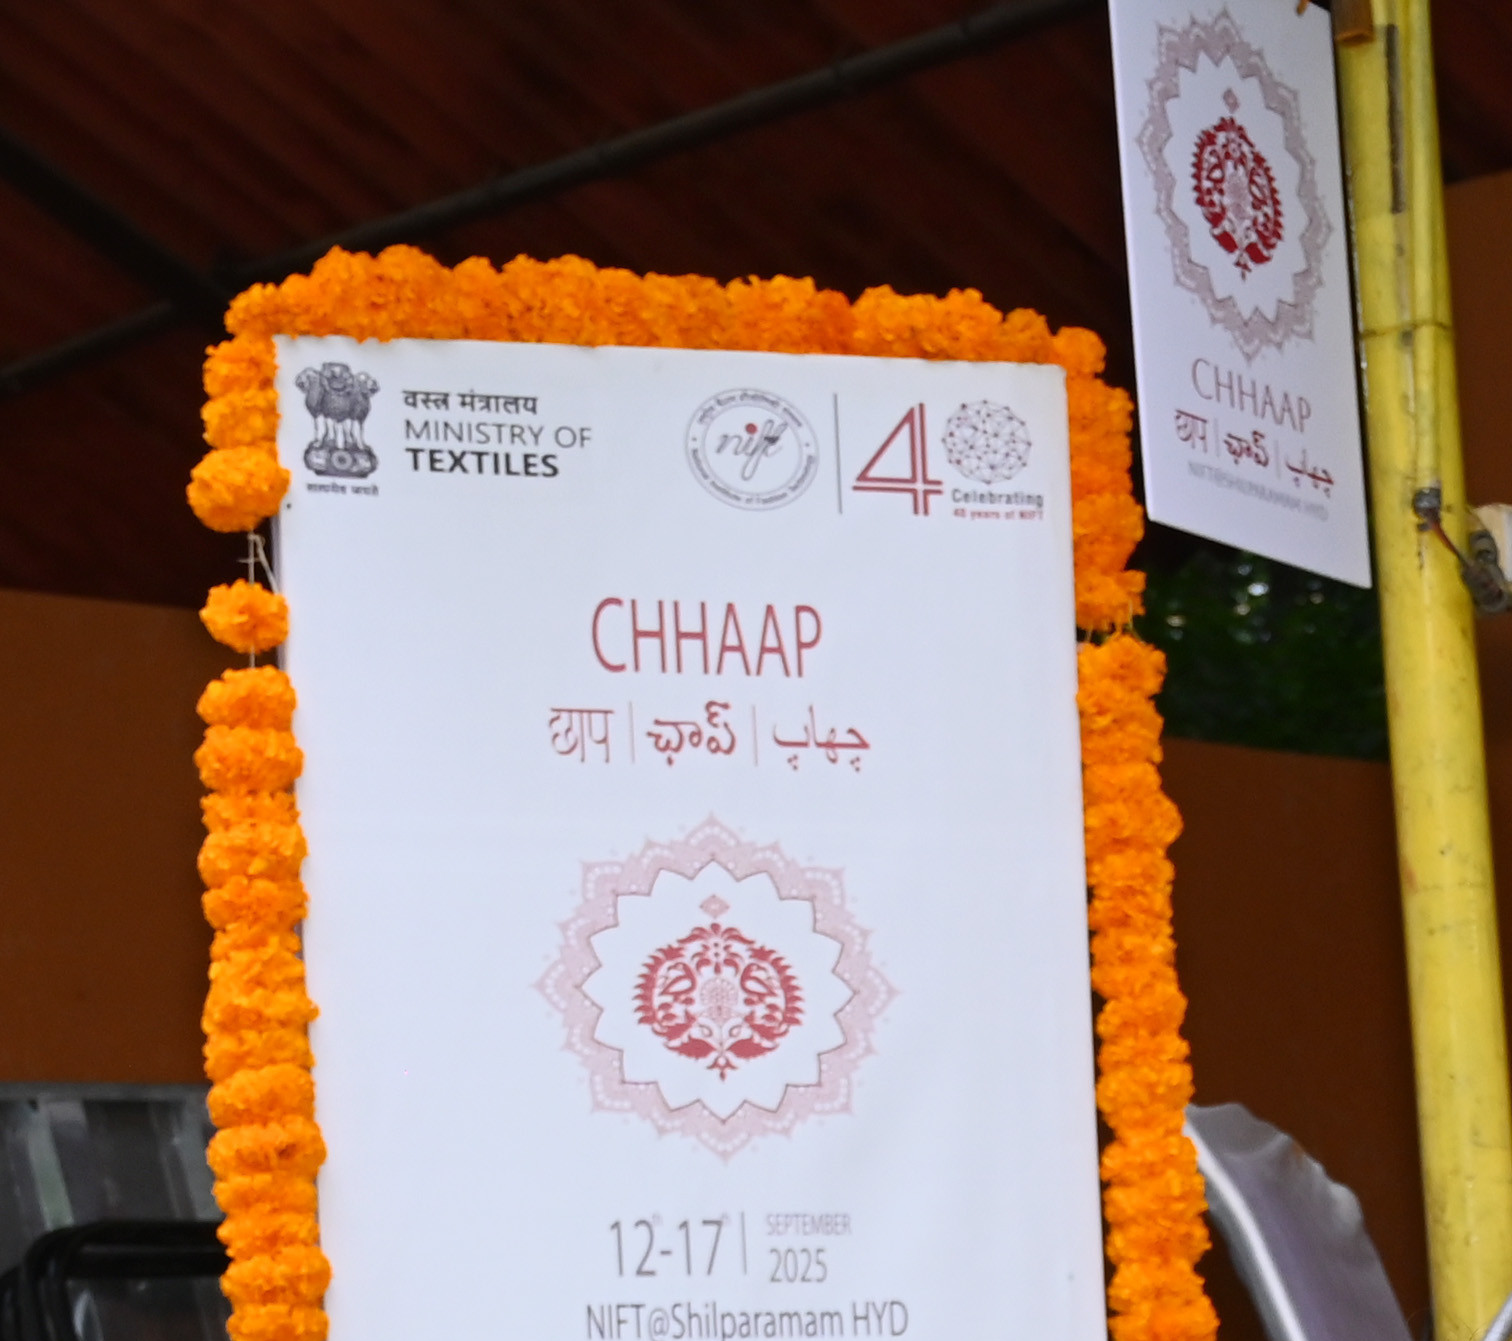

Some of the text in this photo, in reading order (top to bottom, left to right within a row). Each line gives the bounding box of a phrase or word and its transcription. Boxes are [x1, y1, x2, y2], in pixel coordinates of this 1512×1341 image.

[458, 389, 538, 415] मंत्रालय
[1191, 358, 1312, 433] CHHAAP
[405, 419, 592, 448] MINISTRY OF
[405, 448, 559, 478] TEXTILES
[952, 488, 1044, 509] Celebrating
[592, 597, 822, 678] CHHAAP
[549, 708, 614, 763] छाप
[646, 700, 736, 767] ఛాప్
[766, 1213, 851, 1236] SEPTEMBER
[769, 1248, 828, 1283] 2025
[852, 1299, 909, 1337] HYD
